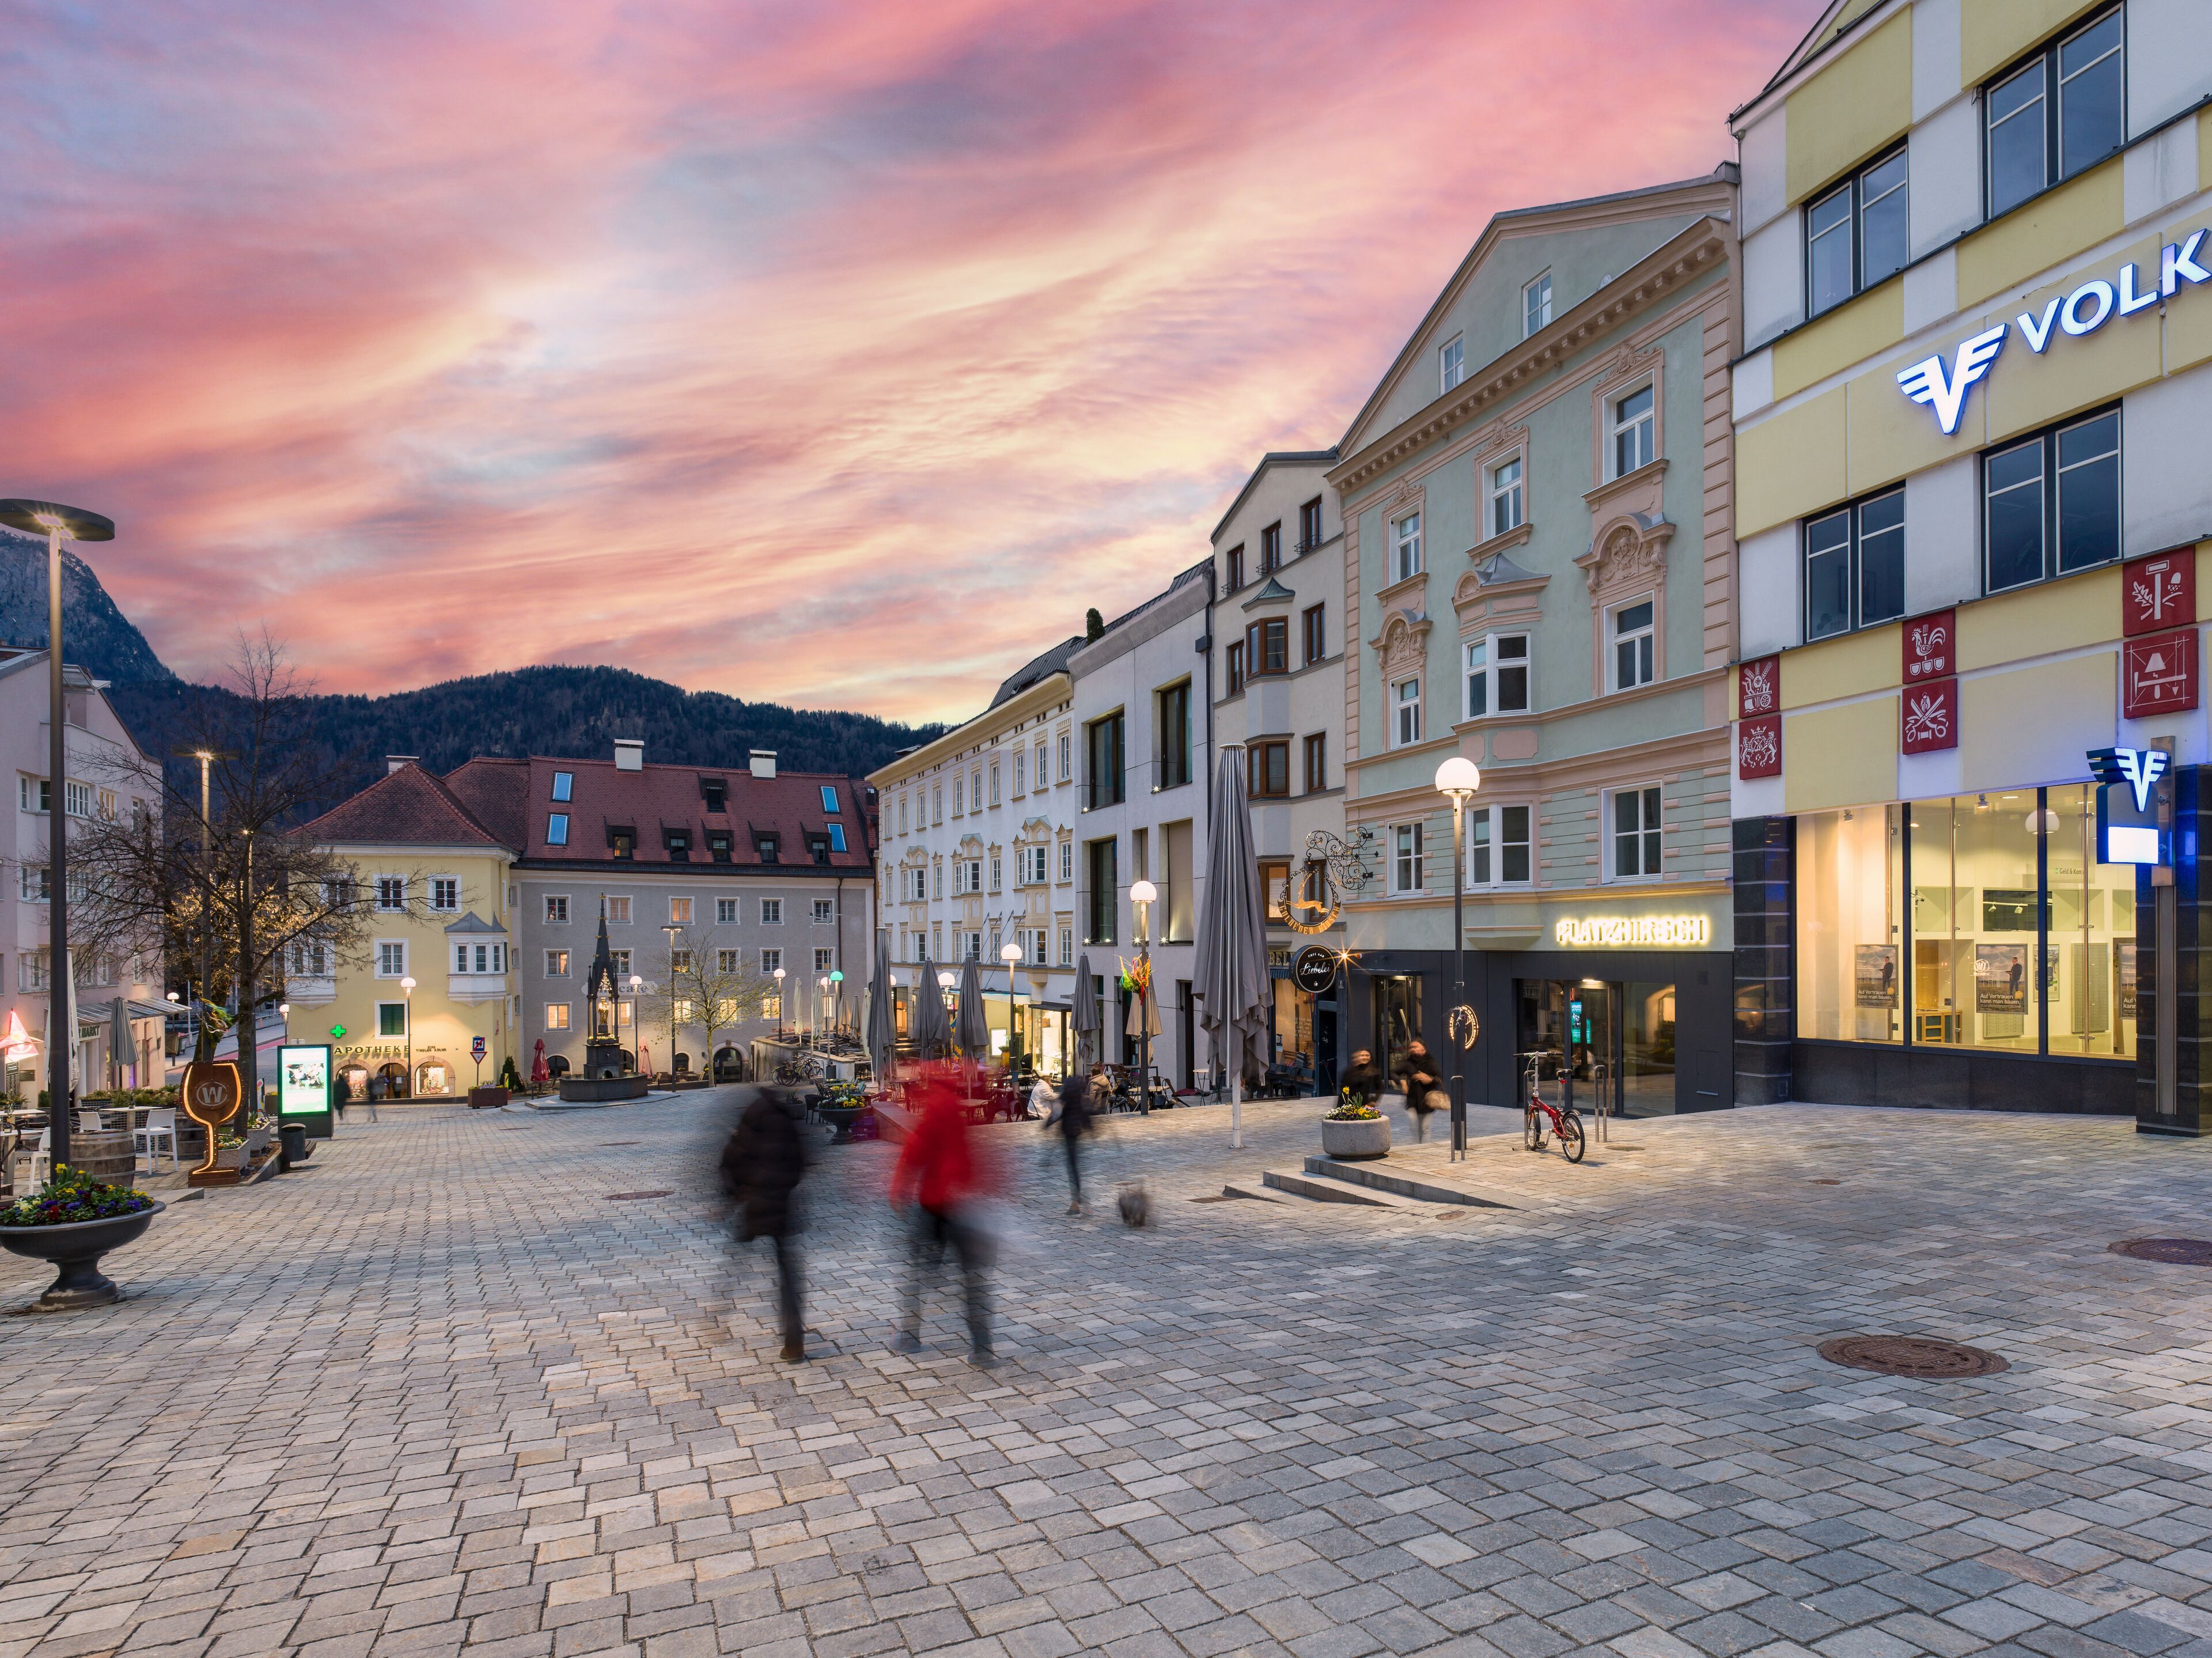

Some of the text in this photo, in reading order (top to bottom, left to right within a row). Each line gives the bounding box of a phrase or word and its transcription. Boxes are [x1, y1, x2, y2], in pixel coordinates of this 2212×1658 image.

[2016, 228, 2212, 353] VOLK
[1556, 916, 1710, 944] PLATZHIRSCH
[1300, 962, 1331, 976] Liebelei
[81, 1025, 100, 1038] MARKT
[334, 1045, 410, 1054] APOTHEKE
[202, 1087, 223, 1103] W
